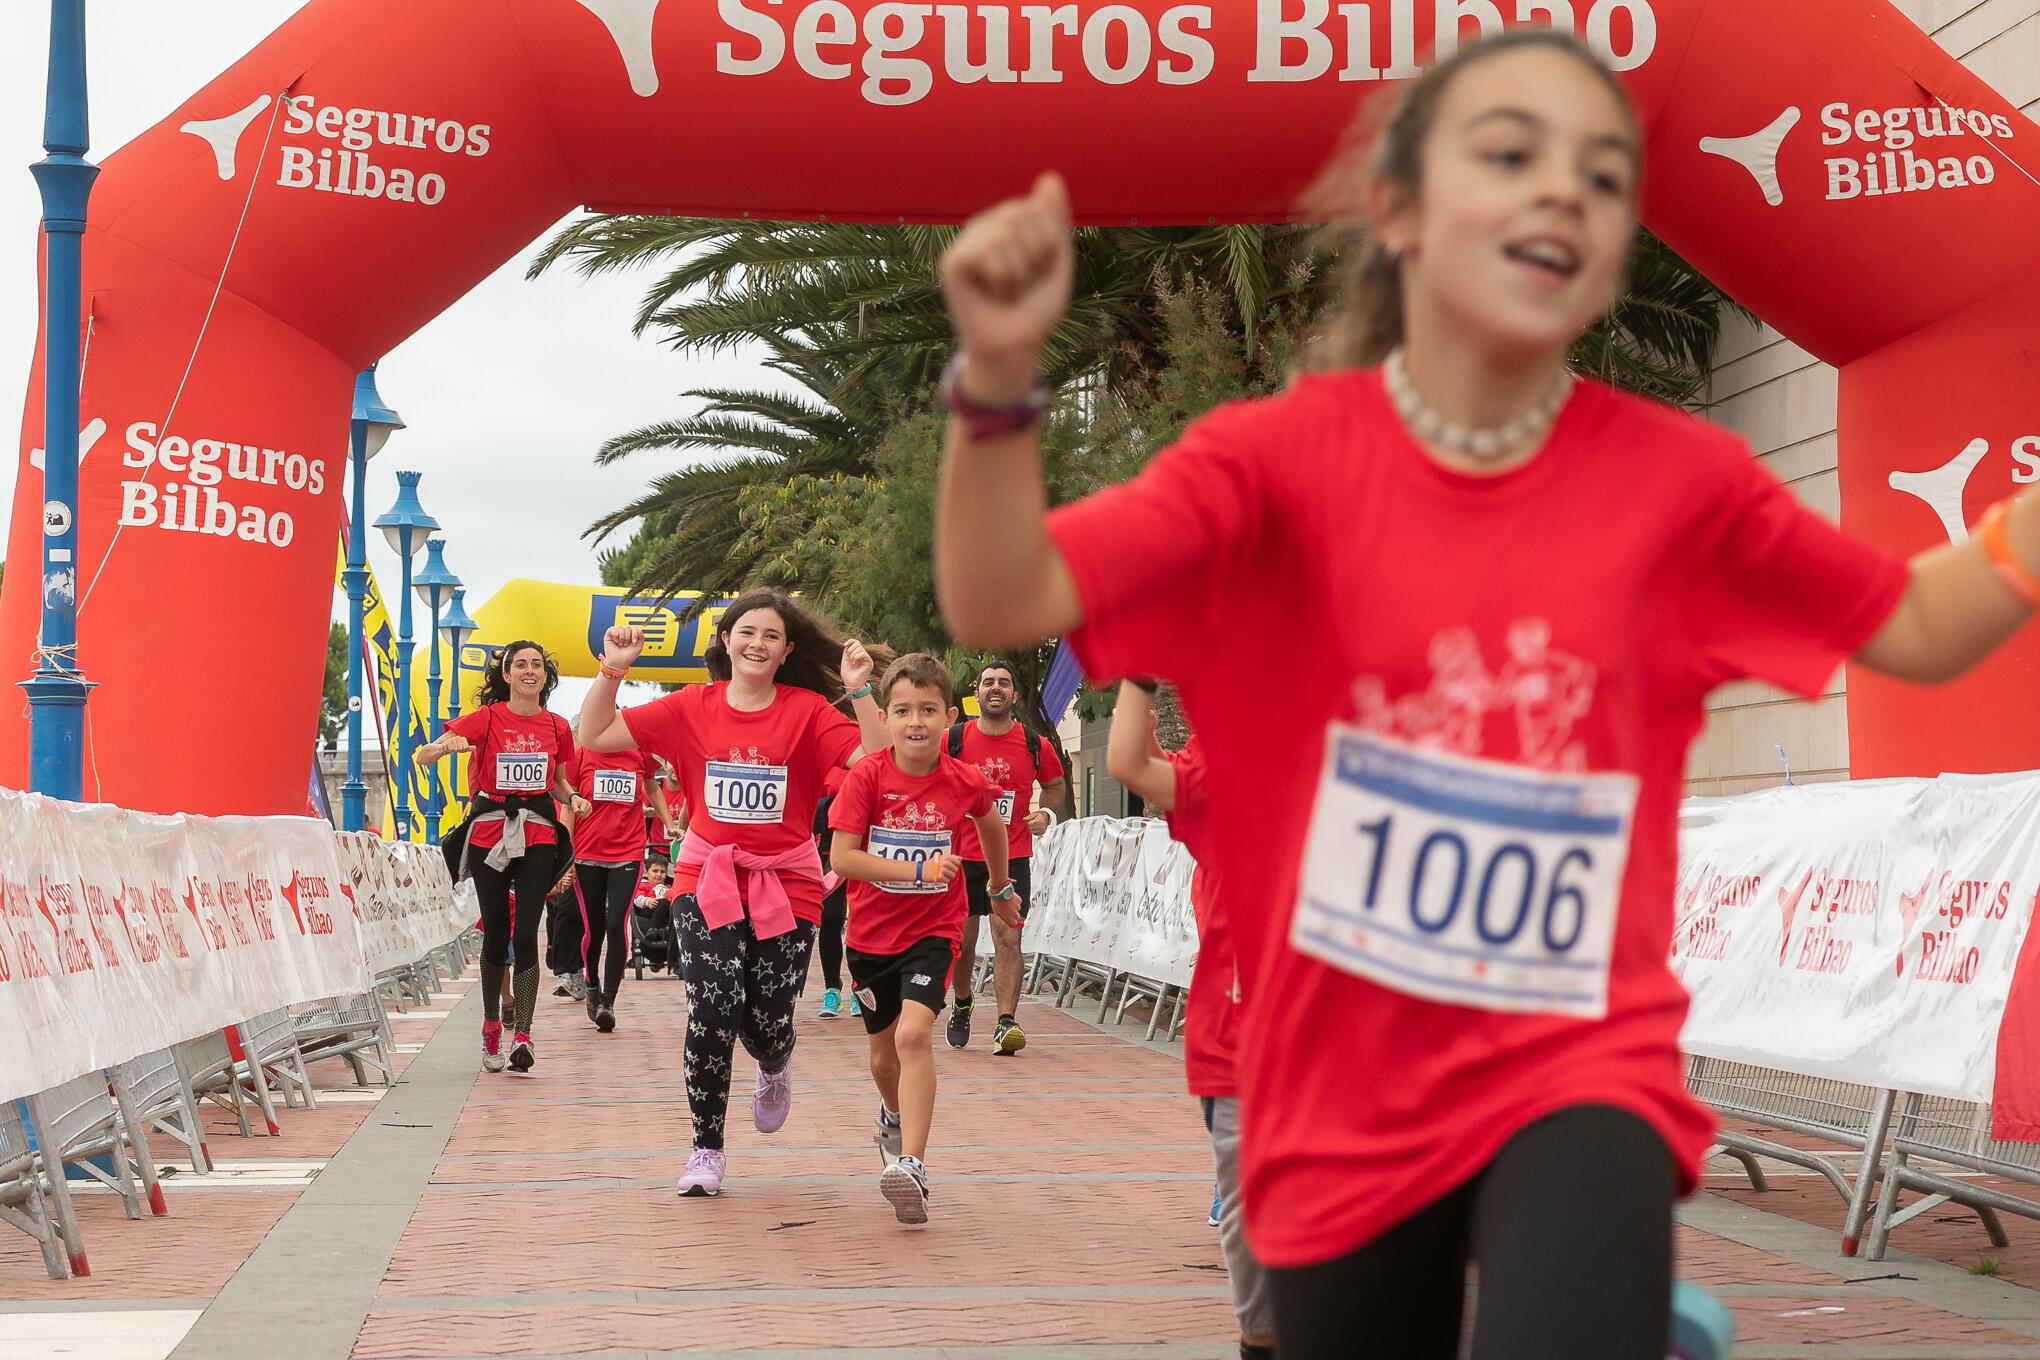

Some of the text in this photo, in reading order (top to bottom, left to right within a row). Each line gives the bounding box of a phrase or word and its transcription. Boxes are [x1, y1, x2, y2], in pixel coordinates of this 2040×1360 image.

[716, 0, 1216, 106] Seguros
[283, 94, 491, 158] Seguros
[1820, 101, 2014, 149] Seguros
[276, 145, 447, 206] Bilbao
[1824, 150, 1995, 201] Bilbao
[121, 420, 326, 497] Seguros
[117, 480, 295, 548] Bilbao
[503, 763, 543, 781] 1006
[600, 779, 632, 794] 1005
[714, 780, 778, 810] 1006
[1357, 813, 1593, 953] 1006
[1796, 925, 1853, 974] Bilbao
